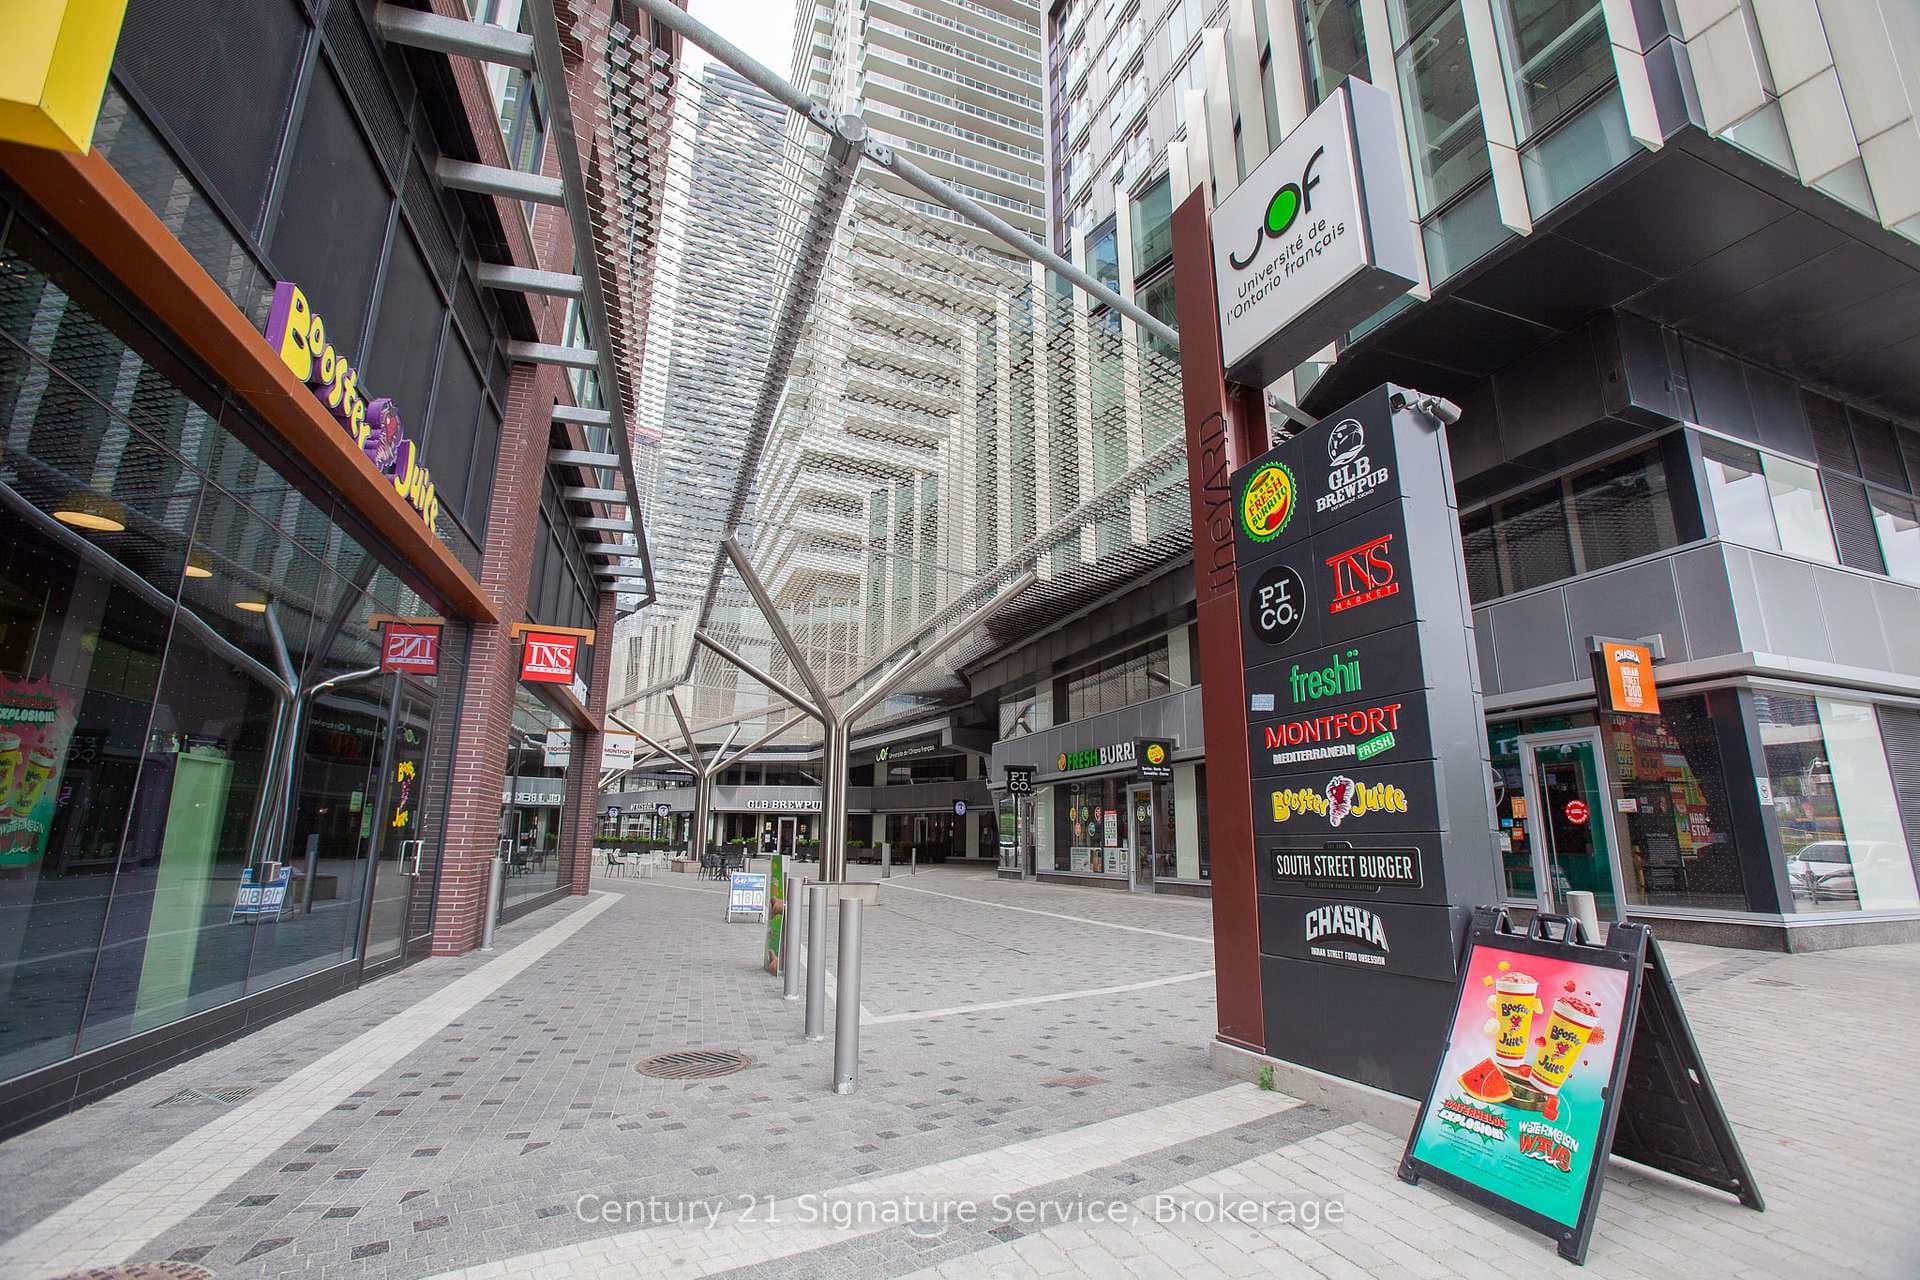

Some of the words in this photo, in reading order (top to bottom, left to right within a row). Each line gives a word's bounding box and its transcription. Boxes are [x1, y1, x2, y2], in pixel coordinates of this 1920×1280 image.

[1226, 274, 1281, 326] l'Ontario
[1284, 221, 1345, 278] français
[1237, 234, 1304, 299] Université
[1308, 218, 1326, 240] de
[280, 286, 372, 450] Booster
[394, 439, 439, 534] Juice
[1328, 456, 1371, 491] GLB
[1248, 476, 1284, 518] FRESH
[1315, 467, 1389, 513] BREWPUB
[1251, 485, 1288, 528] BURRITO
[1328, 541, 1394, 603] INS
[1258, 578, 1291, 609] PI
[1335, 584, 1394, 612] MARKET
[1260, 602, 1299, 630] CO.
[527, 643, 571, 668] INS
[1289, 649, 1362, 704] freshii
[1623, 685, 1643, 697] FOOD
[1264, 703, 1402, 749] MONTFORT
[1067, 752, 1098, 771] FRESH
[1272, 744, 1356, 765] MEDITERRANEAN
[1357, 735, 1393, 759] FRESH
[1010, 771, 1028, 782] PI
[1010, 781, 1031, 792] CO.
[747, 800, 769, 809] GLB
[771, 800, 823, 809] BREWPU
[1271, 787, 1330, 822] Booster
[1350, 782, 1408, 817] Juice
[1276, 854, 1311, 876] SOUTH
[1313, 855, 1355, 878] STREET
[1359, 855, 1413, 880] BURGER
[1305, 905, 1389, 952] CHASKA
[1327, 950, 1344, 960] STREET
[1344, 951, 1358, 961] FOOD
[1444, 1099, 1507, 1128] WATERMELON
